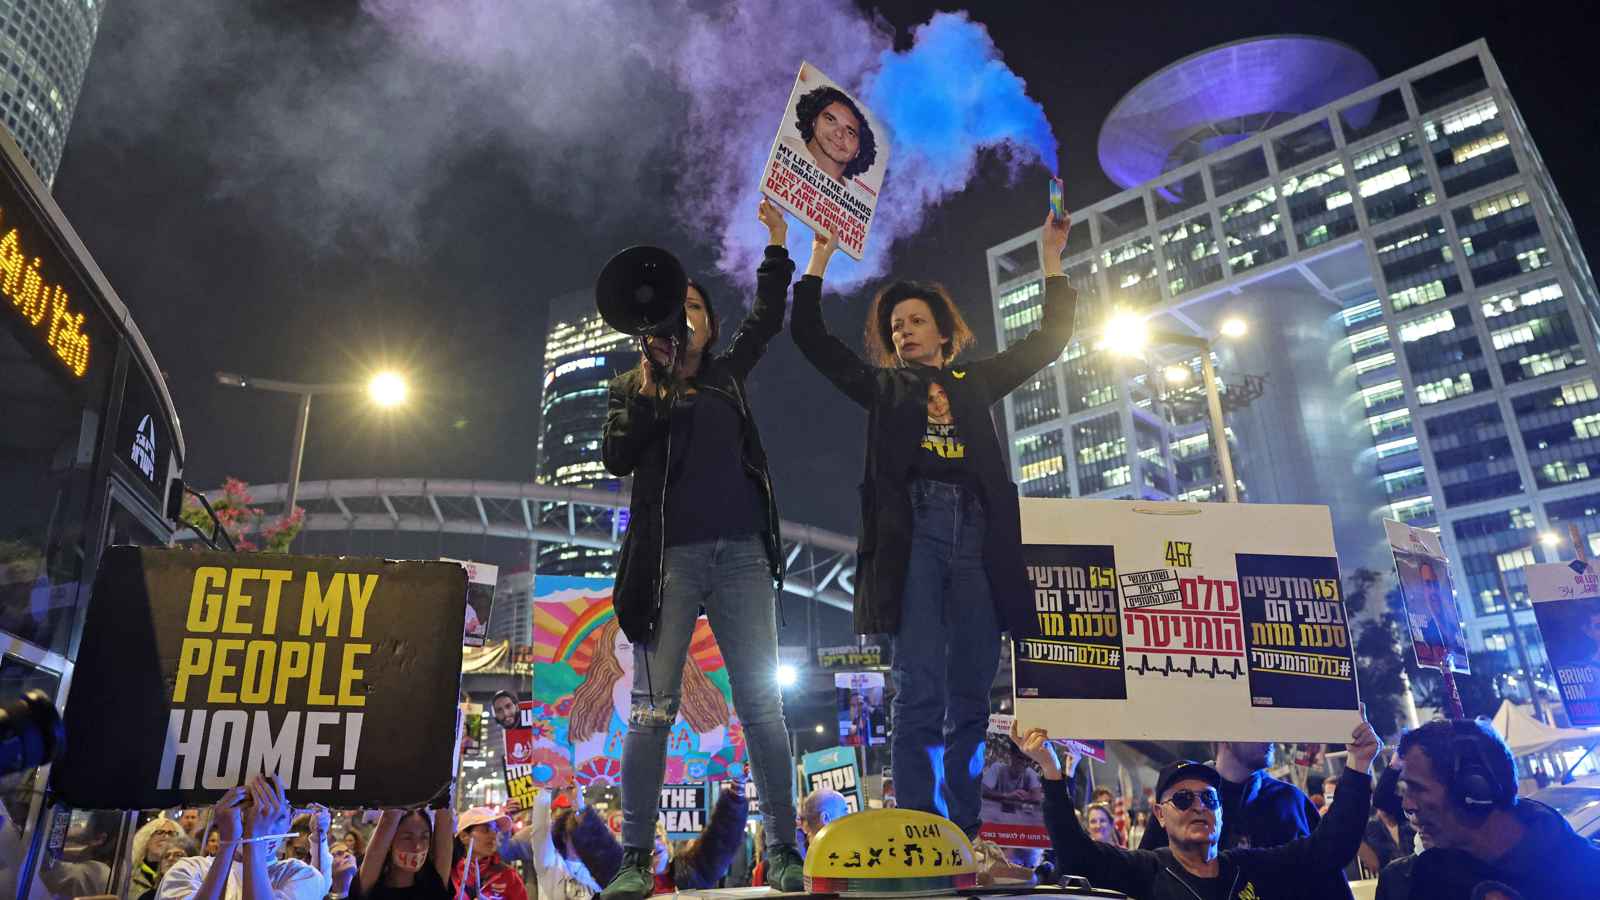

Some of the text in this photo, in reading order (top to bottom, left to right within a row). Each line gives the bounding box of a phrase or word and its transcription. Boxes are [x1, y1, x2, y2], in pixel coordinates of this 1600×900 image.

[779, 144, 792, 157] MY
[793, 154, 813, 173] LIFE
[813, 169, 819, 178] IS
[827, 178, 842, 195] THE
[843, 192, 871, 216] HANDS
[772, 169, 864, 241] THEY ARE SIGNING MY
[773, 161, 780, 169] IF
[783, 167, 800, 184] THEY
[802, 182, 822, 200] DON'T
[824, 198, 840, 214] SIGN
[848, 216, 865, 234] DEAL
[791, 164, 819, 188] ISRAELI
[821, 186, 868, 224] GOVERNMENT
[767, 178, 862, 252] DEATH WARANT!
[1027, 566, 1086, 588] חודשי
[1242, 576, 1336, 600] 15 חודשים
[186, 567, 379, 638] GET MY
[1034, 590, 1117, 612] בשבי הם
[1129, 594, 1160, 607] החטופים
[1180, 576, 1239, 612] כולם
[1264, 599, 1343, 624] בשבי הם
[1069, 614, 1118, 637] סכנת
[1124, 614, 1243, 651] הומניטרי
[1250, 622, 1346, 648] סכנת מוות
[172, 638, 372, 706] PEOPLE
[1251, 651, 1351, 677] #כולםהומניטרי
[1558, 667, 1593, 685] BRING
[1563, 684, 1586, 701] HIM
[156, 709, 364, 790] HOME!
[662, 788, 697, 809] THE
